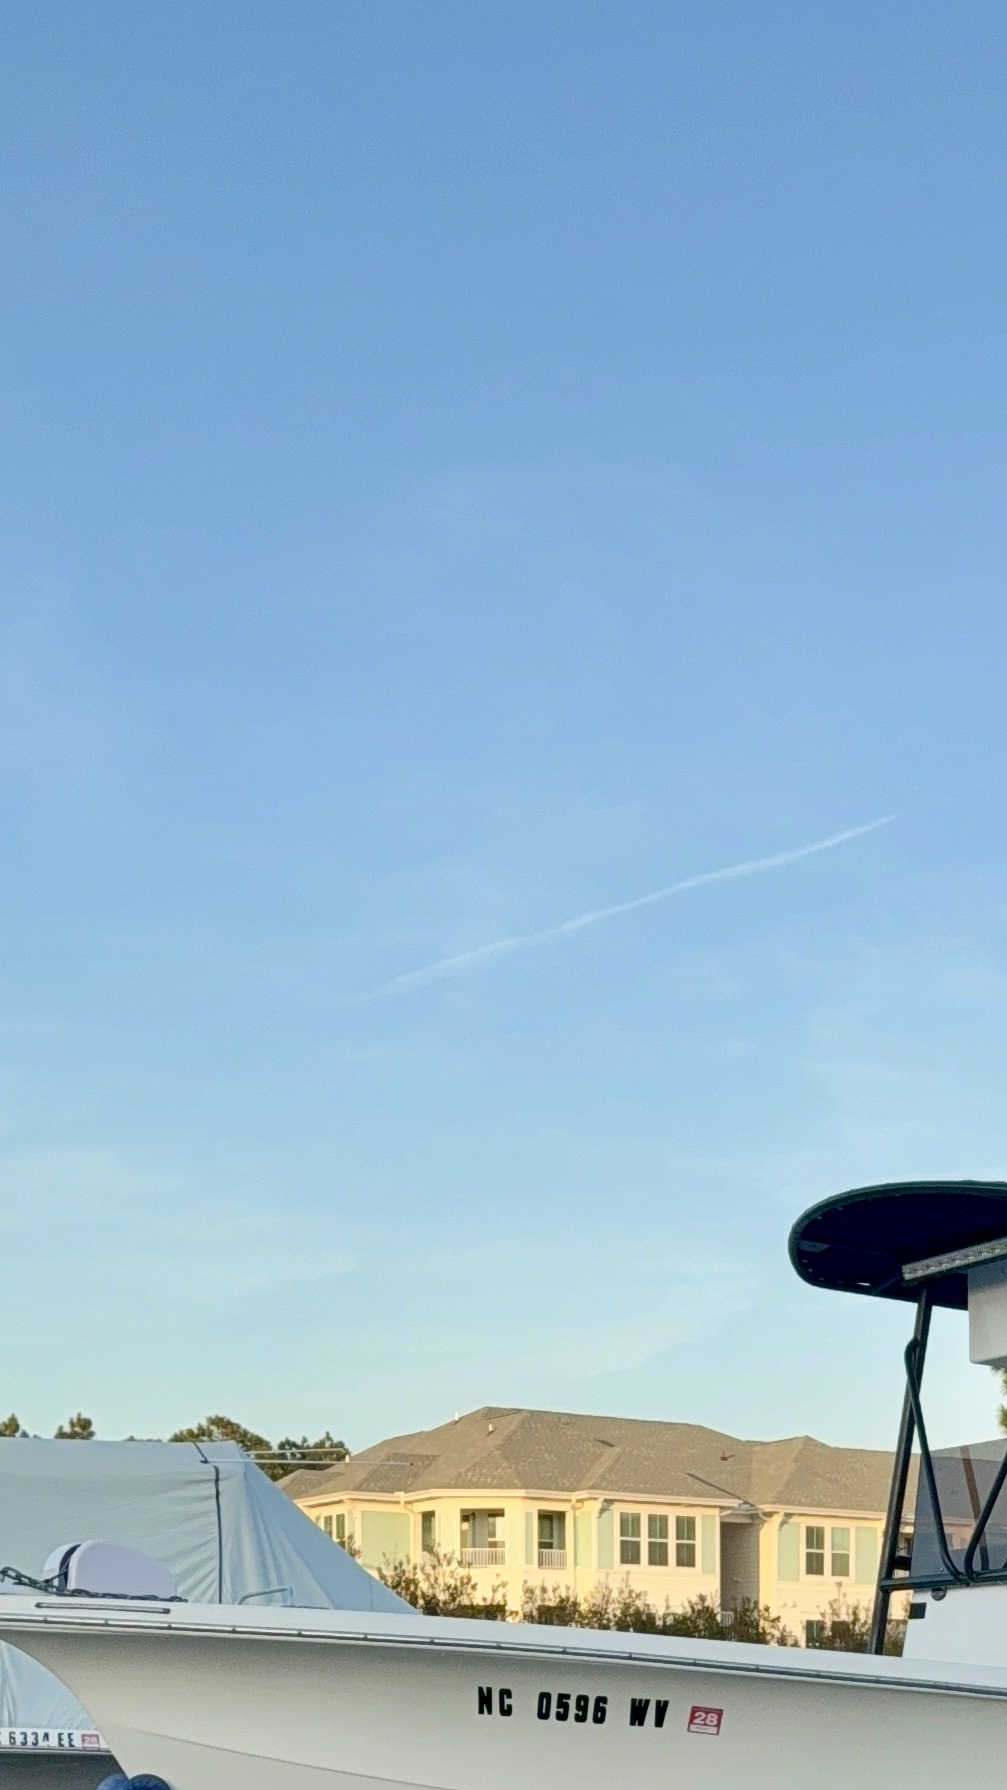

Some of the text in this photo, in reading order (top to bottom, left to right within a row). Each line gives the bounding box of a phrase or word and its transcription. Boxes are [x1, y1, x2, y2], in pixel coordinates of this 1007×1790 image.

[477, 1686, 670, 1728] NC 0596 WV
[692, 1711, 719, 1726] 28
[57, 1732, 75, 1748] EE
